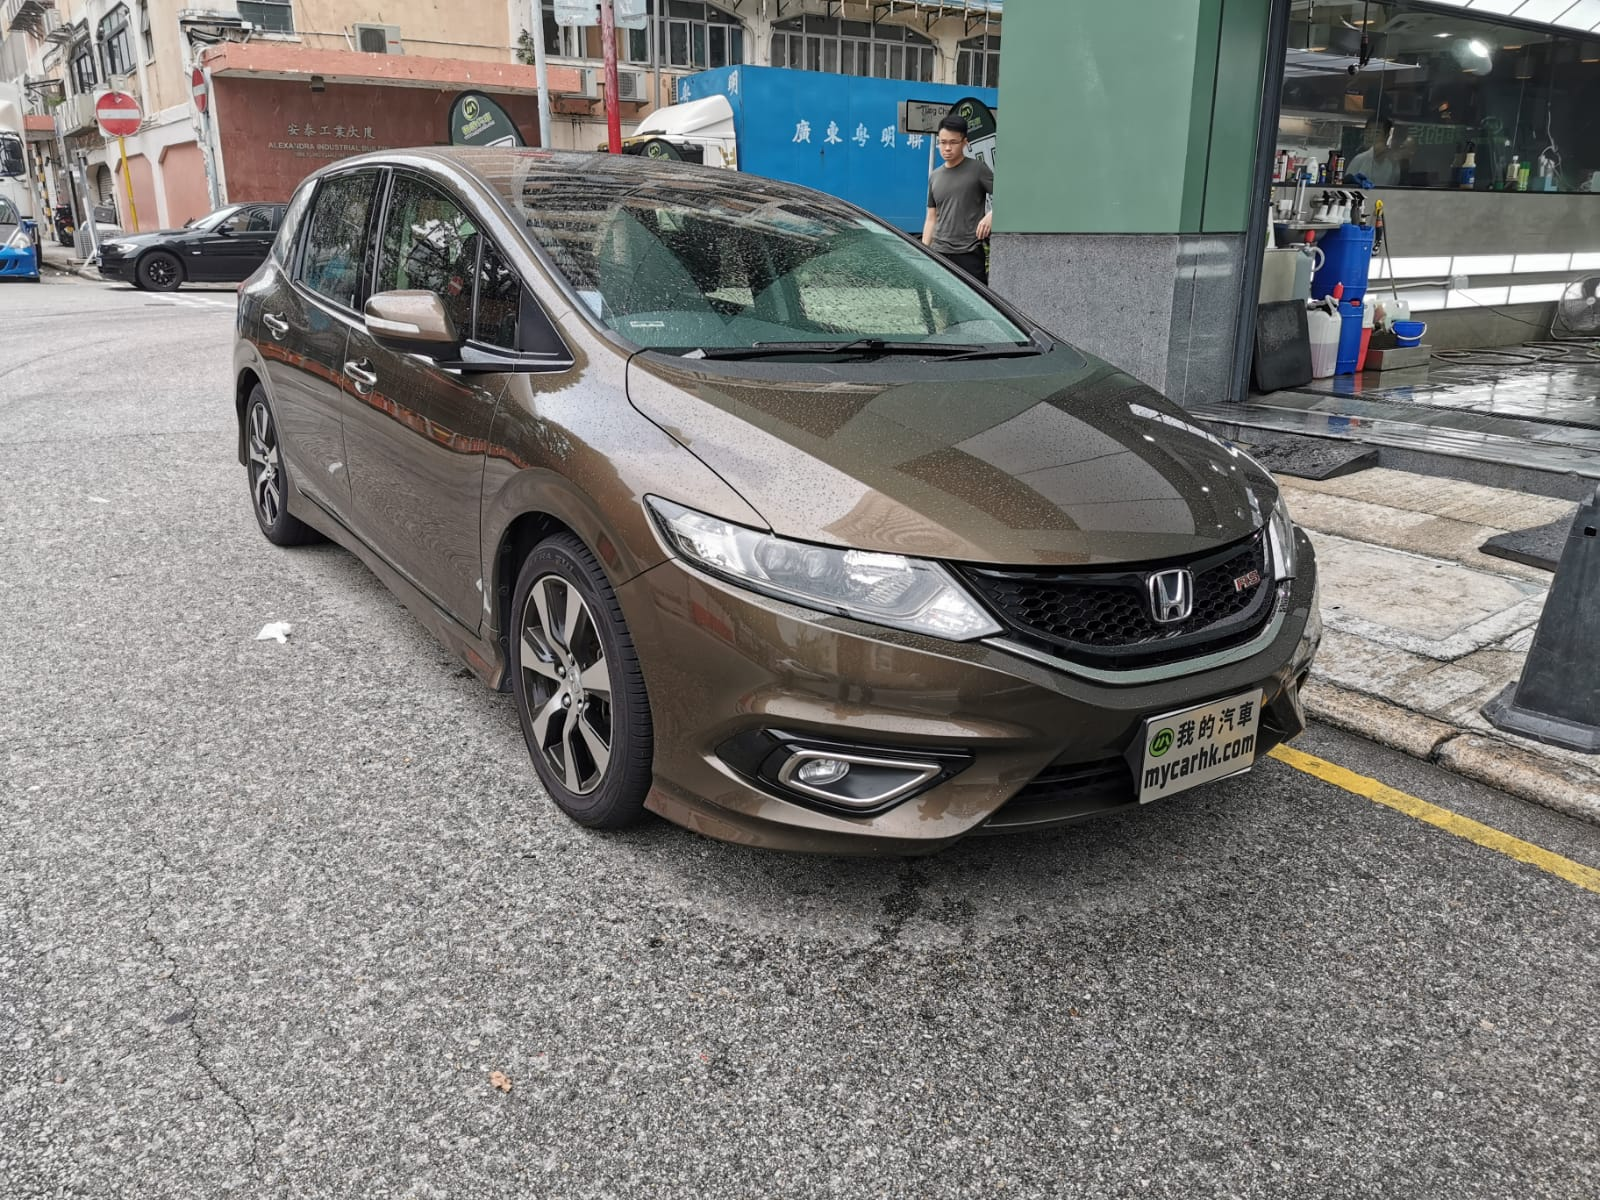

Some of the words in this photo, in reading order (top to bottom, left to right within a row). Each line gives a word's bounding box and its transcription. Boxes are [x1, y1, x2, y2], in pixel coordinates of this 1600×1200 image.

[268, 142, 314, 151] ALEXANDRA
[316, 143, 360, 152] INDUSTRIAL
[1234, 569, 1260, 592] RS
[1177, 701, 1254, 748] 我的汽車
[1144, 734, 1254, 789] mycarhk.com
